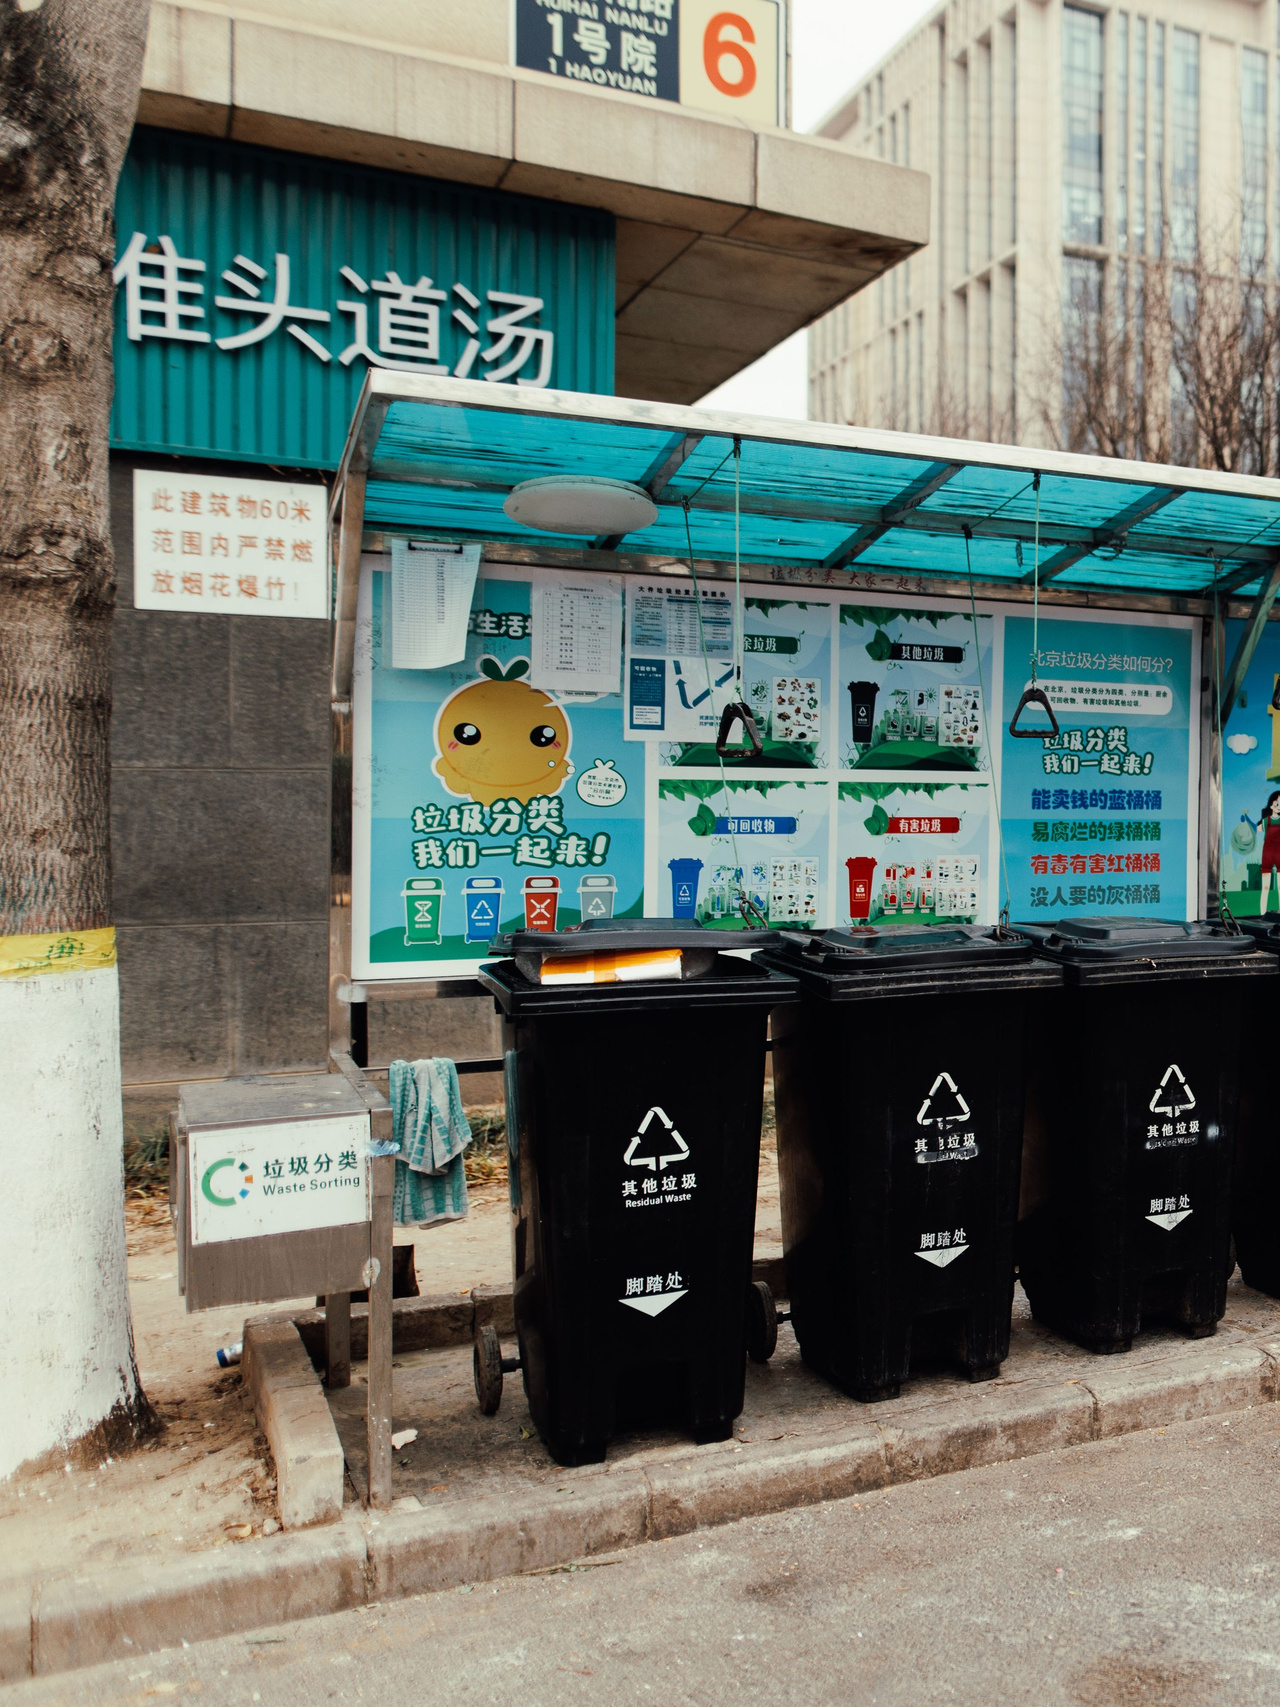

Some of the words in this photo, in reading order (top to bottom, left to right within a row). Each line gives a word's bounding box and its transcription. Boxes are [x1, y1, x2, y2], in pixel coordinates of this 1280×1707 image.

[605, 8, 668, 36] NANLU
[547, 12, 657, 77] 1号院
[703, 12, 757, 98] 6
[548, 57, 558, 74] 1
[565, 60, 657, 96] HAOYUAN
[152, 488, 311, 523] 此建筑物60米
[152, 528, 313, 563] 范围内严禁燃
[848, 571, 928, 592] 大家一起来
[471, 611, 532, 636] 生活
[901, 645, 944, 662] 其他垃圾
[1042, 727, 1128, 752] 垃圾分类
[1043, 753, 1153, 774] 我们一起来！
[1031, 789, 1162, 811] 能卖钱的蓝桶桶
[412, 797, 565, 835] 垃圾分类
[727, 818, 776, 834] 可回收物
[898, 818, 942, 833] 有害垃圾
[1031, 821, 1161, 843] 易腐烂的绿桶桶
[412, 834, 610, 869] 我们一起来！
[1030, 853, 1161, 875] 有毒有害红桶桶
[1030, 884, 1161, 907] 没人要的灰桶桶
[1146, 1120, 1200, 1139] 其他垃圾
[263, 1150, 359, 1180] 垃圾分类
[263, 1181, 306, 1197] Waste
[310, 1176, 360, 1191] Sorting
[621, 1173, 697, 1197] 其他垃圾
[625, 1194, 663, 1209] Residual
[664, 1192, 692, 1204] Waste
[1149, 1194, 1191, 1214] 脚踏处
[920, 1227, 967, 1249] 脚踏处
[625, 1271, 683, 1296] 脚踏处
